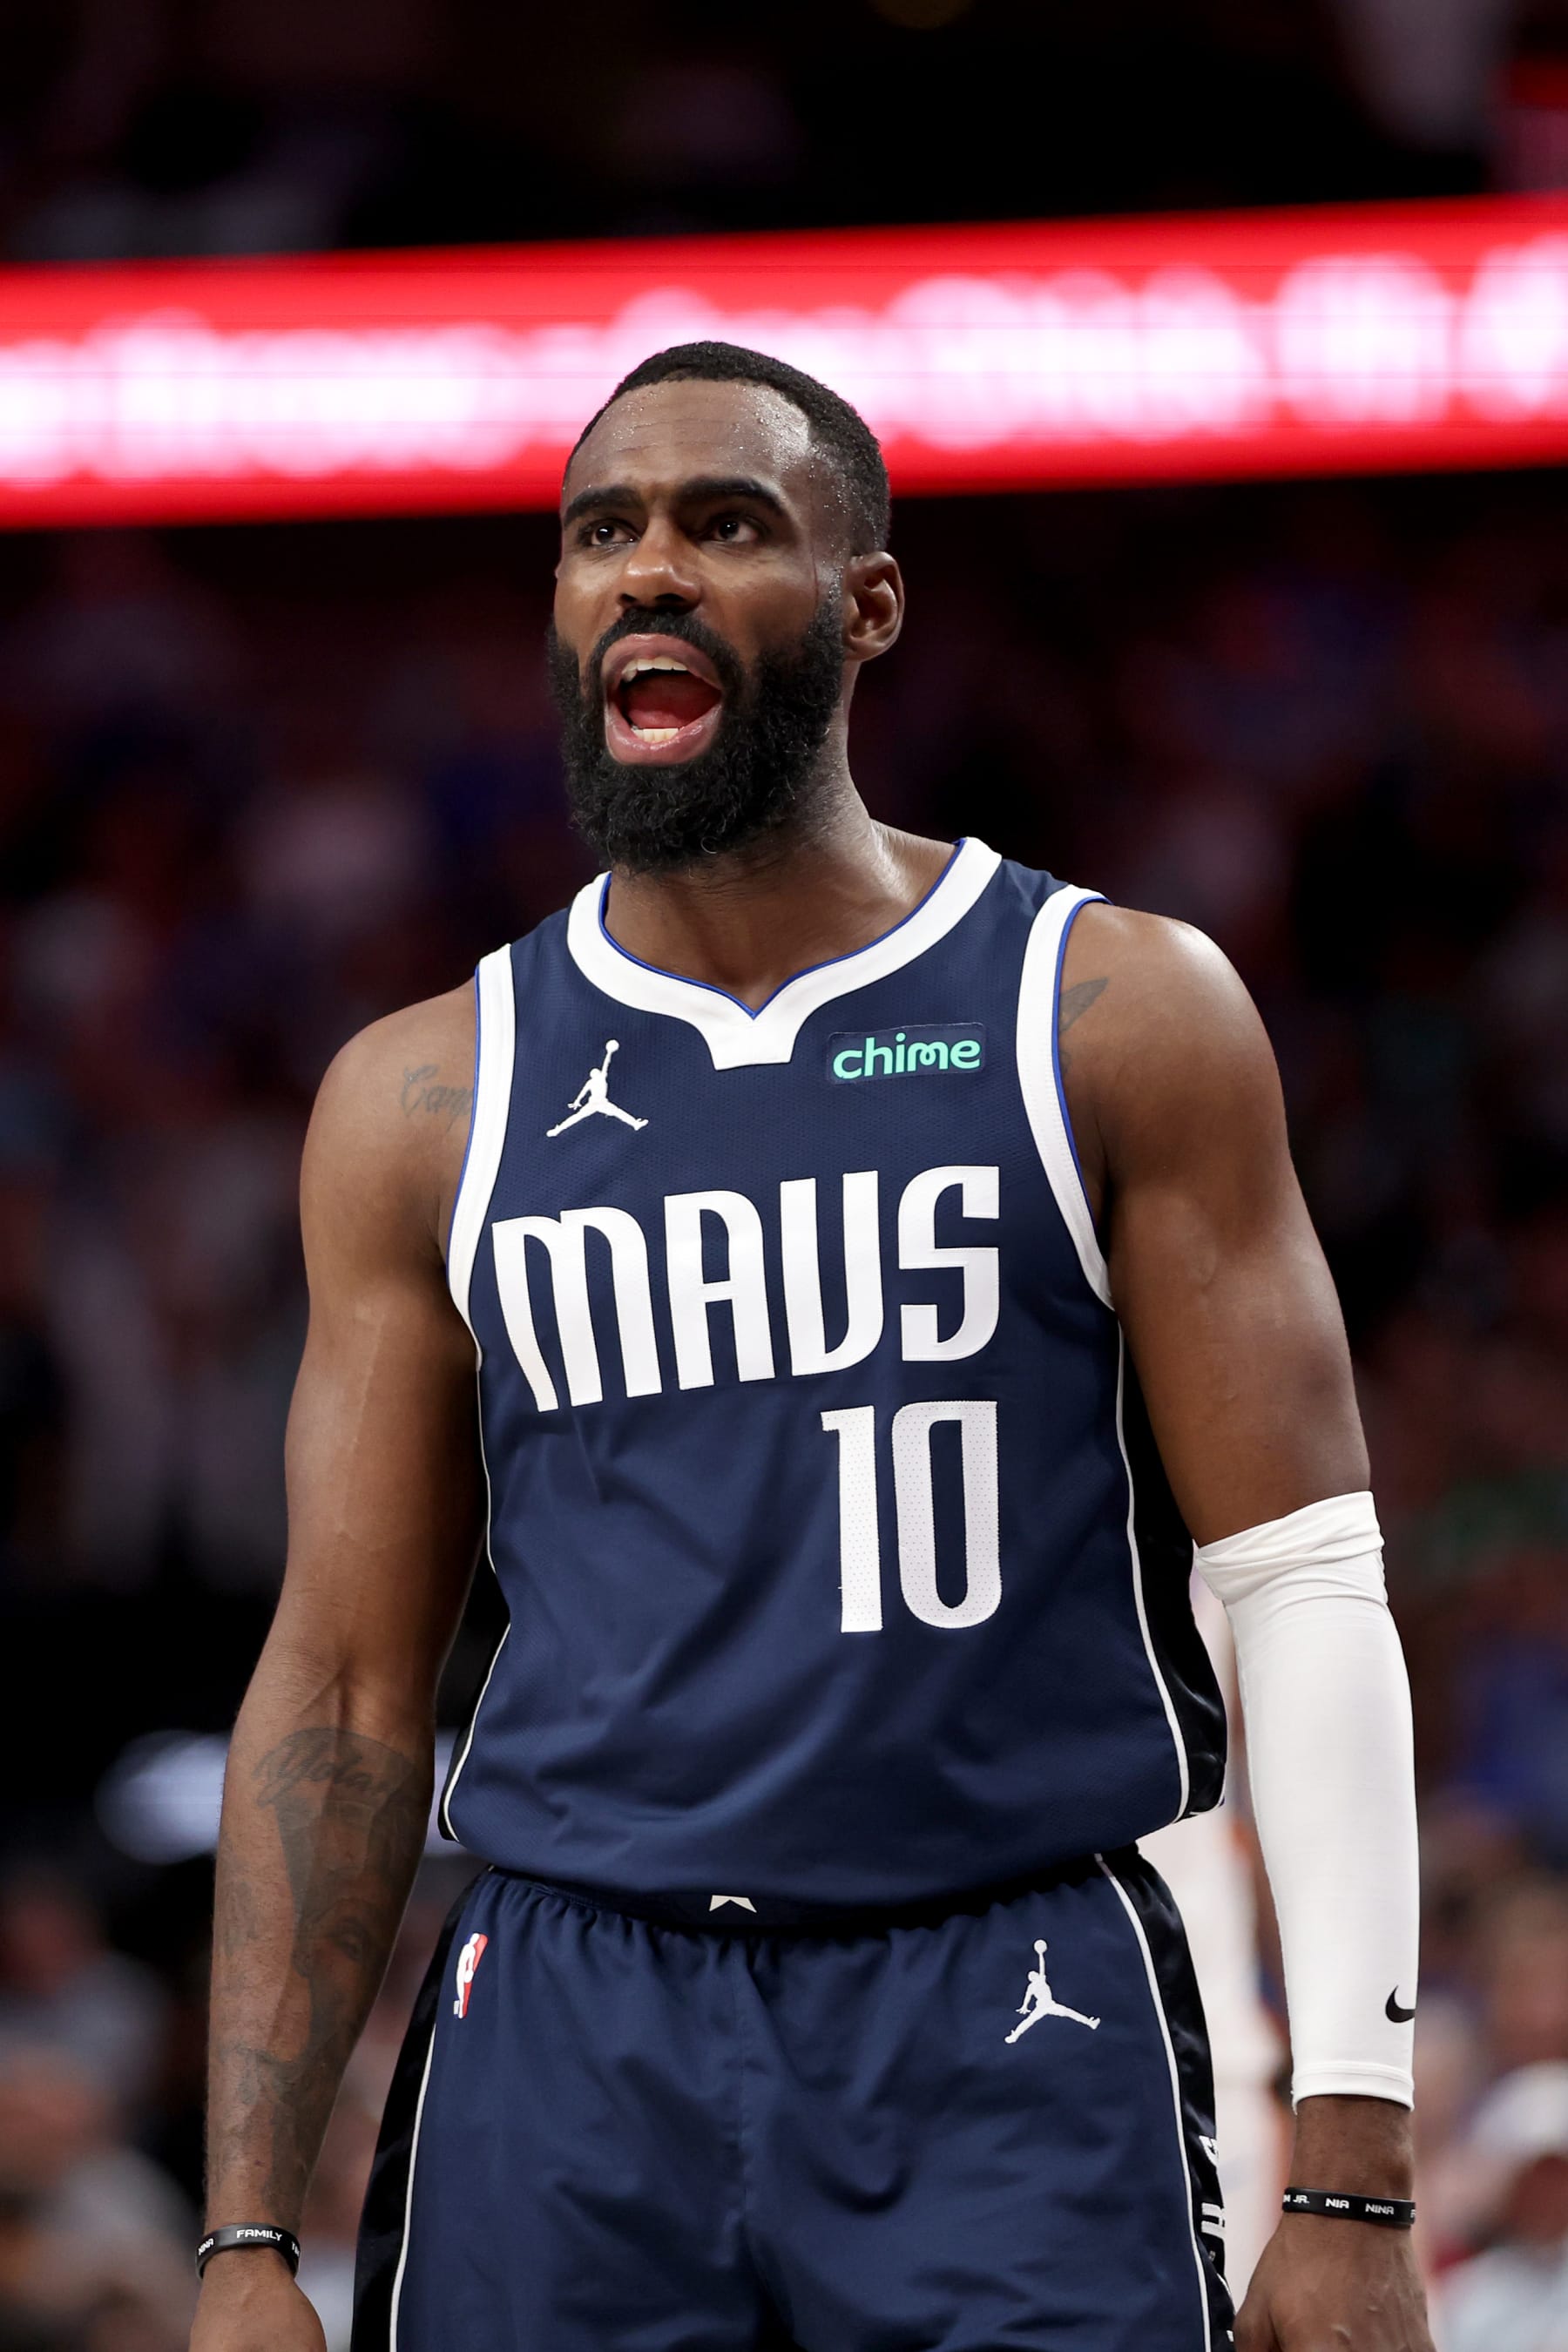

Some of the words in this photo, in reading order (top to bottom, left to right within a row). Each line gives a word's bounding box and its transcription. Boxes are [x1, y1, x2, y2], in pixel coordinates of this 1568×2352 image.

[833, 1032, 981, 1079] chime
[492, 1166, 1000, 1412] MAVS
[821, 1400, 1003, 1633] 10
[1325, 2198, 1350, 2209] NIA
[1365, 2203, 1395, 2215] NINA
[236, 2229, 282, 2241] FAMILY
